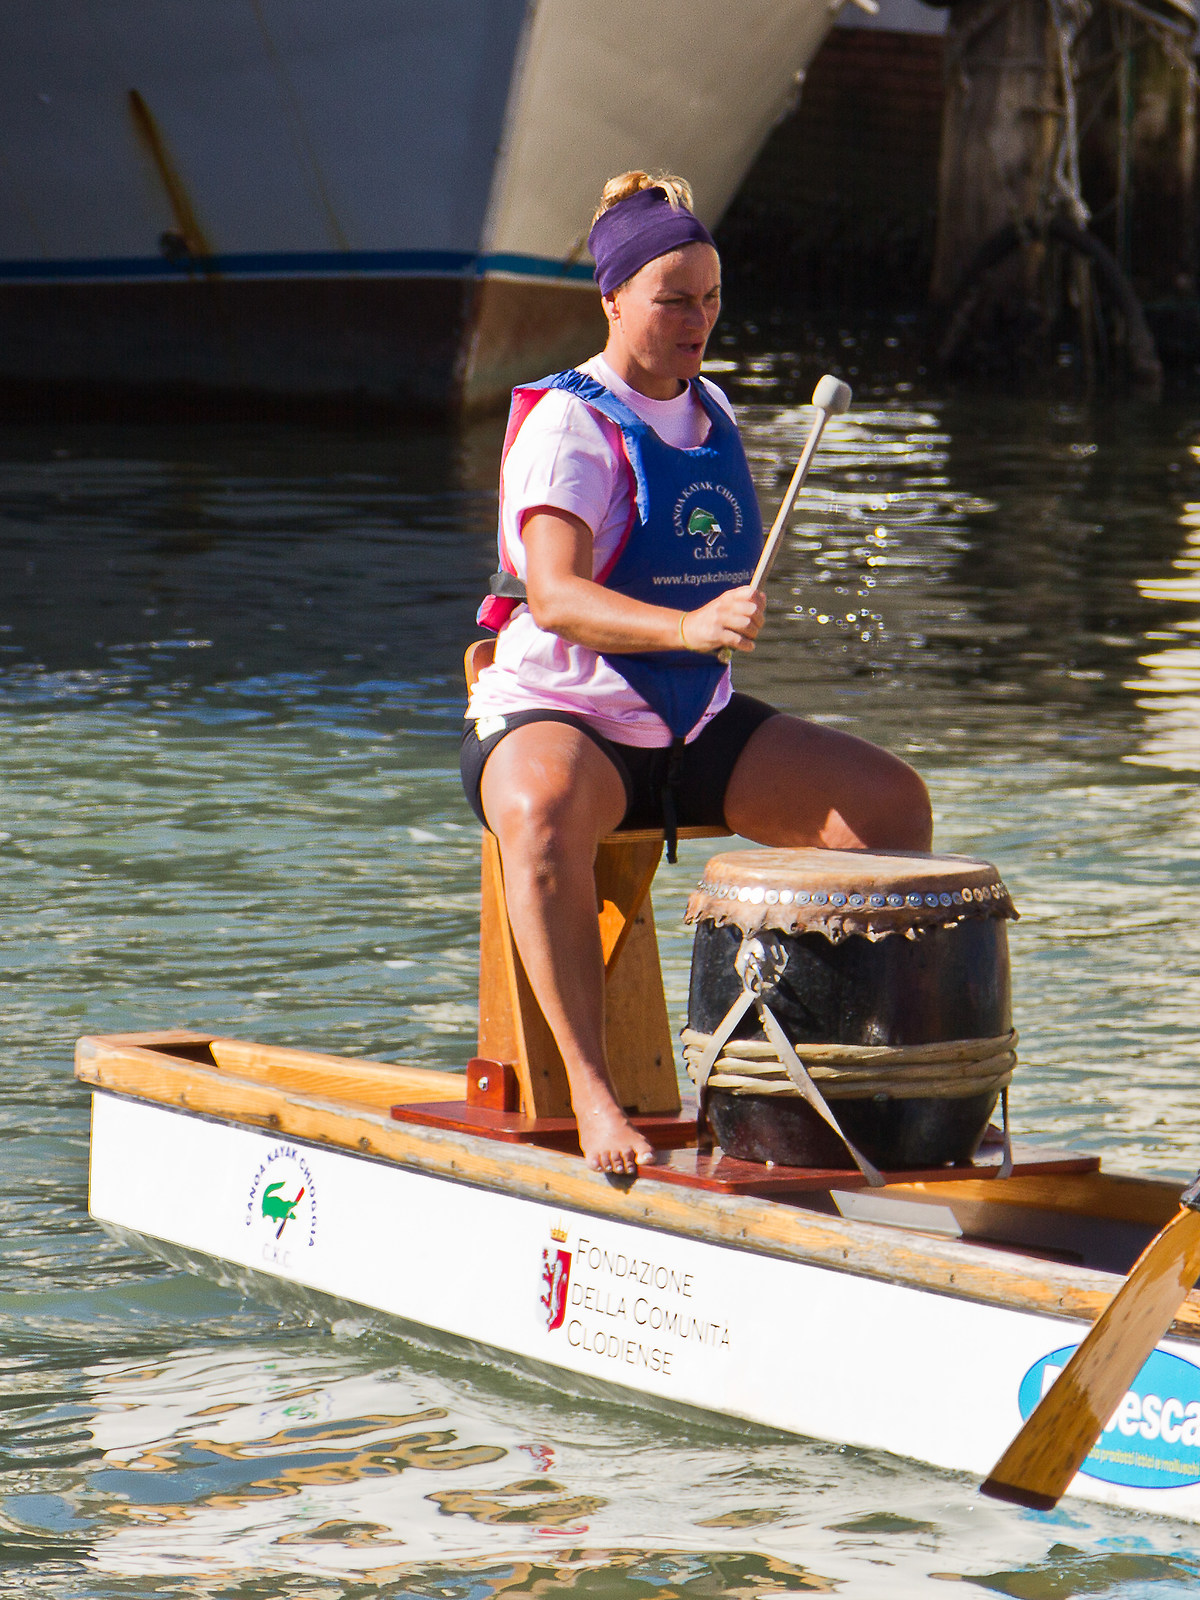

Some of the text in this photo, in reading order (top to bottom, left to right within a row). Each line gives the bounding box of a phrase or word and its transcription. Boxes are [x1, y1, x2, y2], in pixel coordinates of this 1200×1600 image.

[681, 480, 714, 500] KAYAK
[576, 1237, 695, 1298] FONDAZIONE
[571, 1283, 627, 1320] DELLA
[566, 1319, 674, 1376] CLODIENSE
